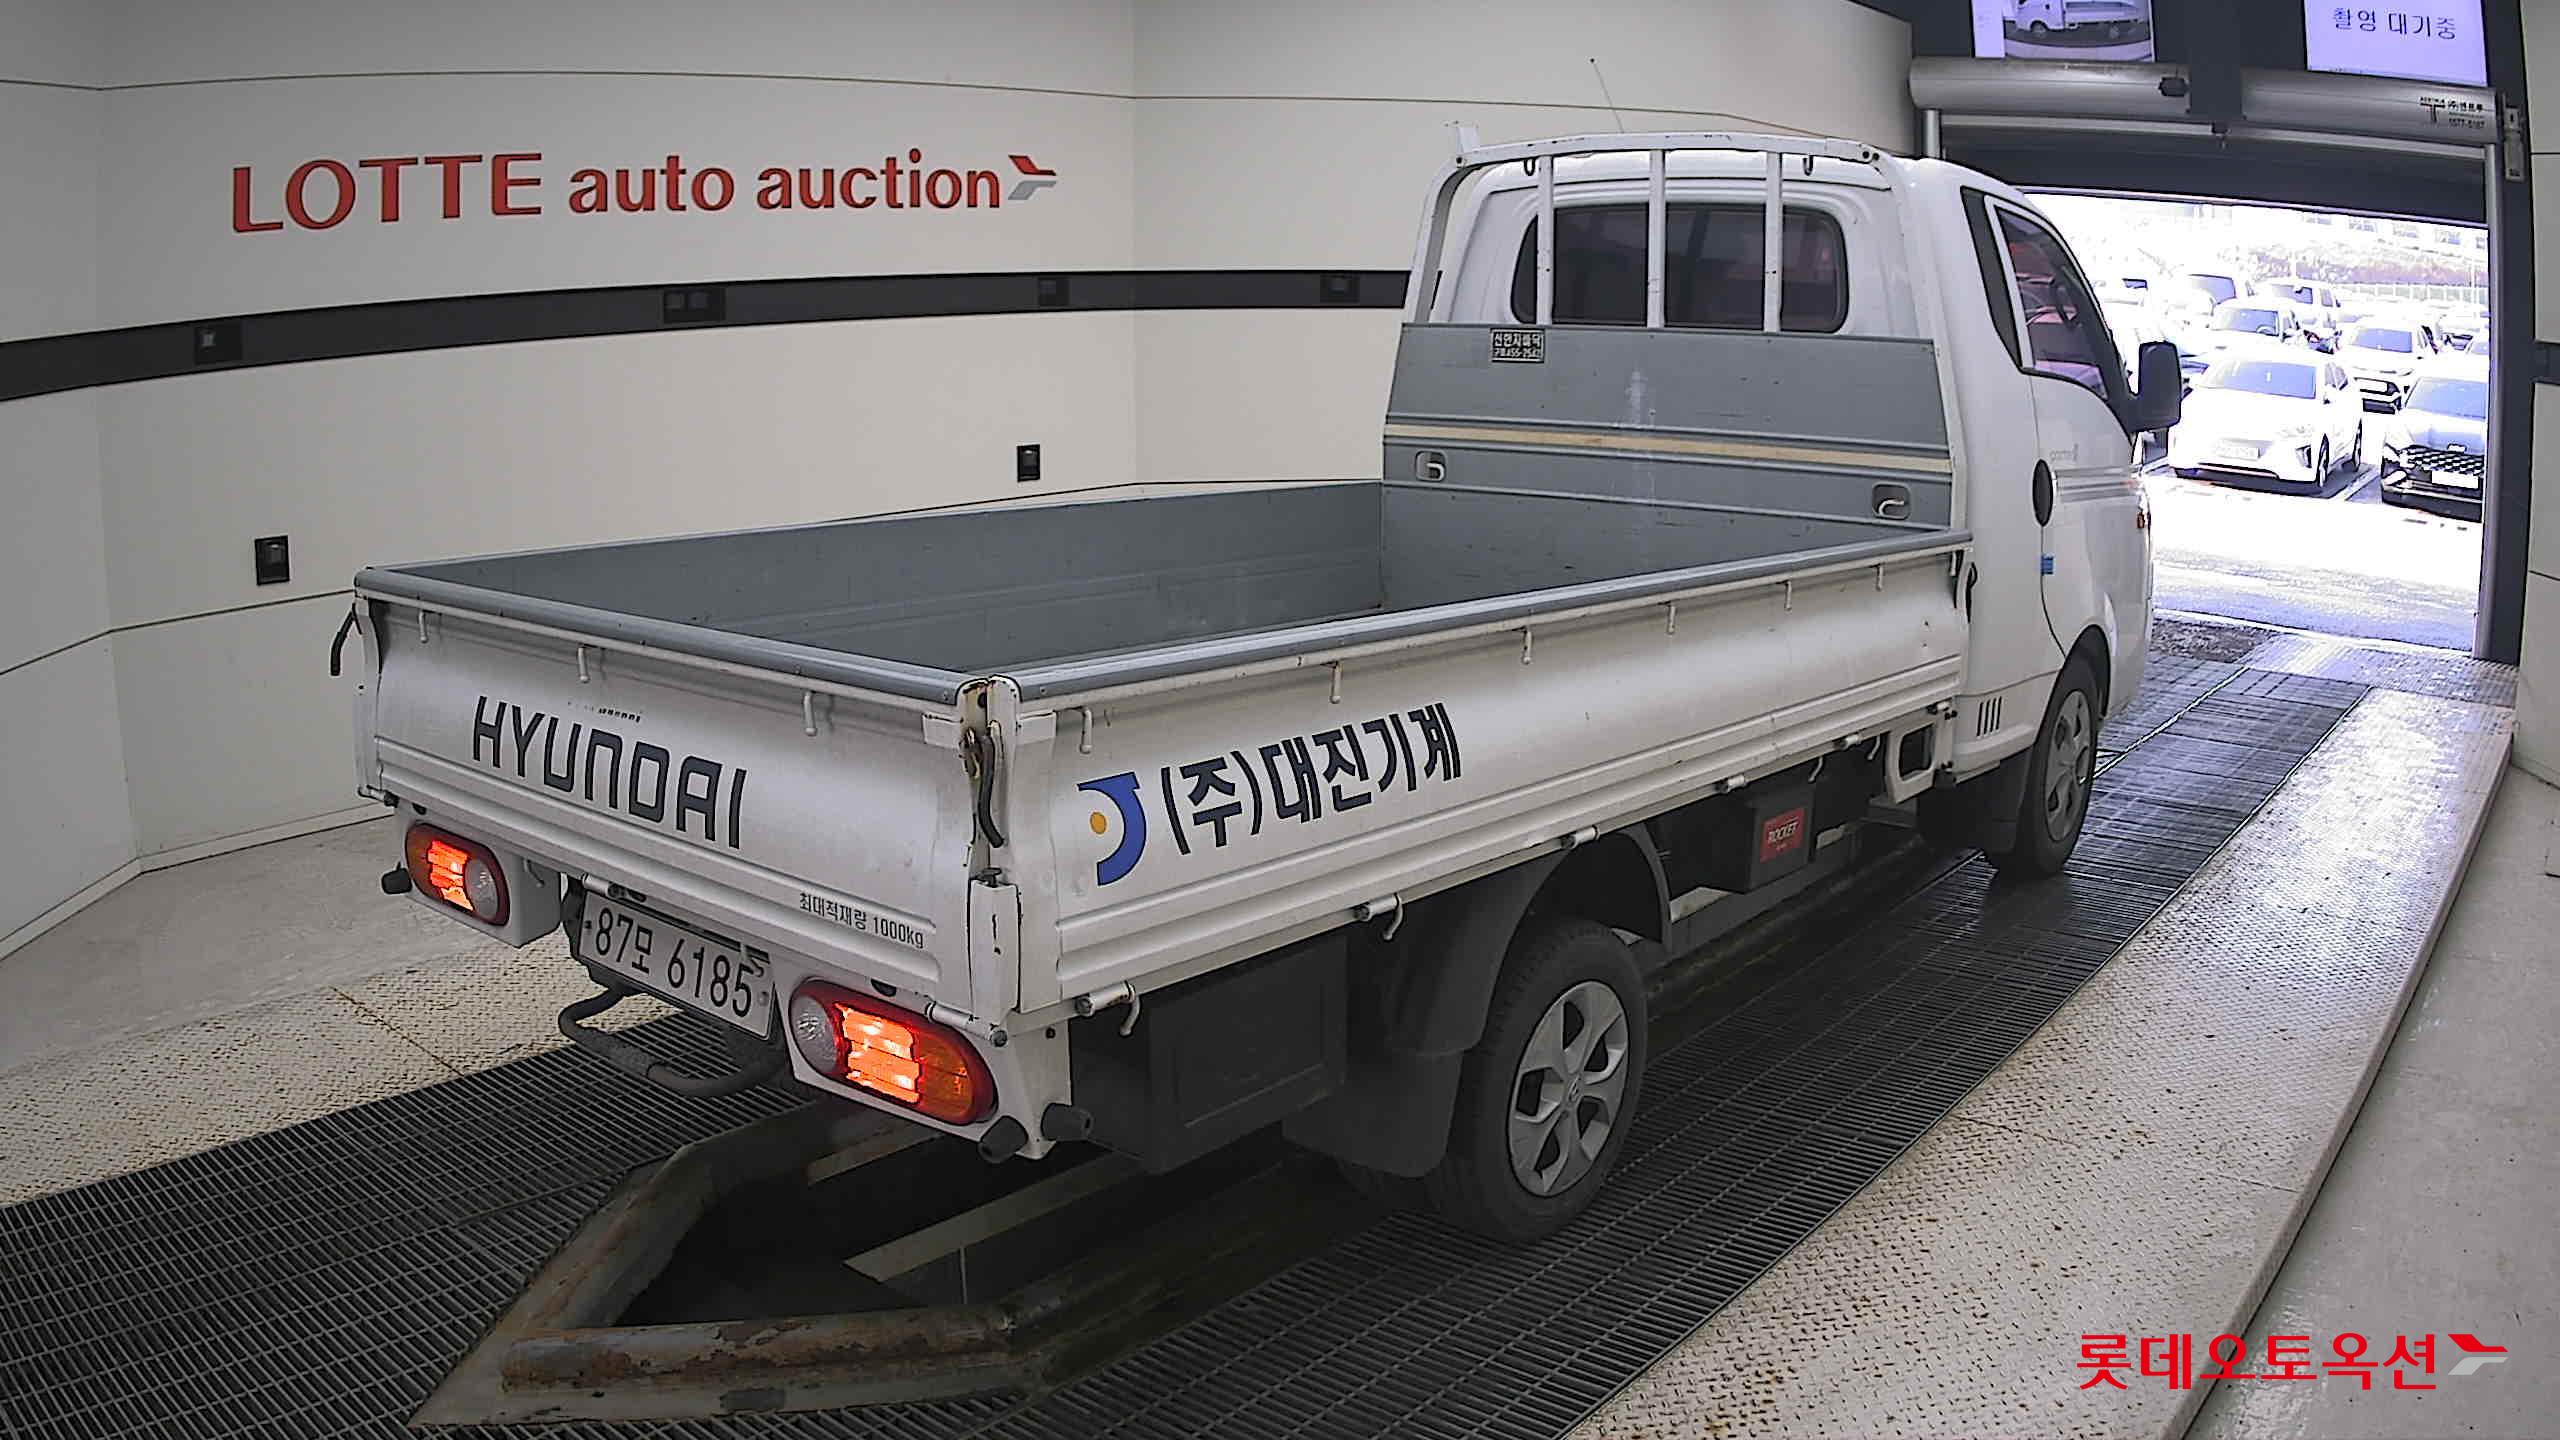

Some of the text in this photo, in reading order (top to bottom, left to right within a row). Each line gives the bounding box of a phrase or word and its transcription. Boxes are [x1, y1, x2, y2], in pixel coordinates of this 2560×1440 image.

[2333, 8, 2456, 40] 촬영 대기중
[232, 147, 1002, 233] LOTTE auto auction
[473, 696, 747, 849] HYUNDAI
[1161, 702, 1461, 855] (주)대진기계
[596, 907, 752, 1018] 87모 6185
[799, 892, 924, 949] 최대적재량 1000kg
